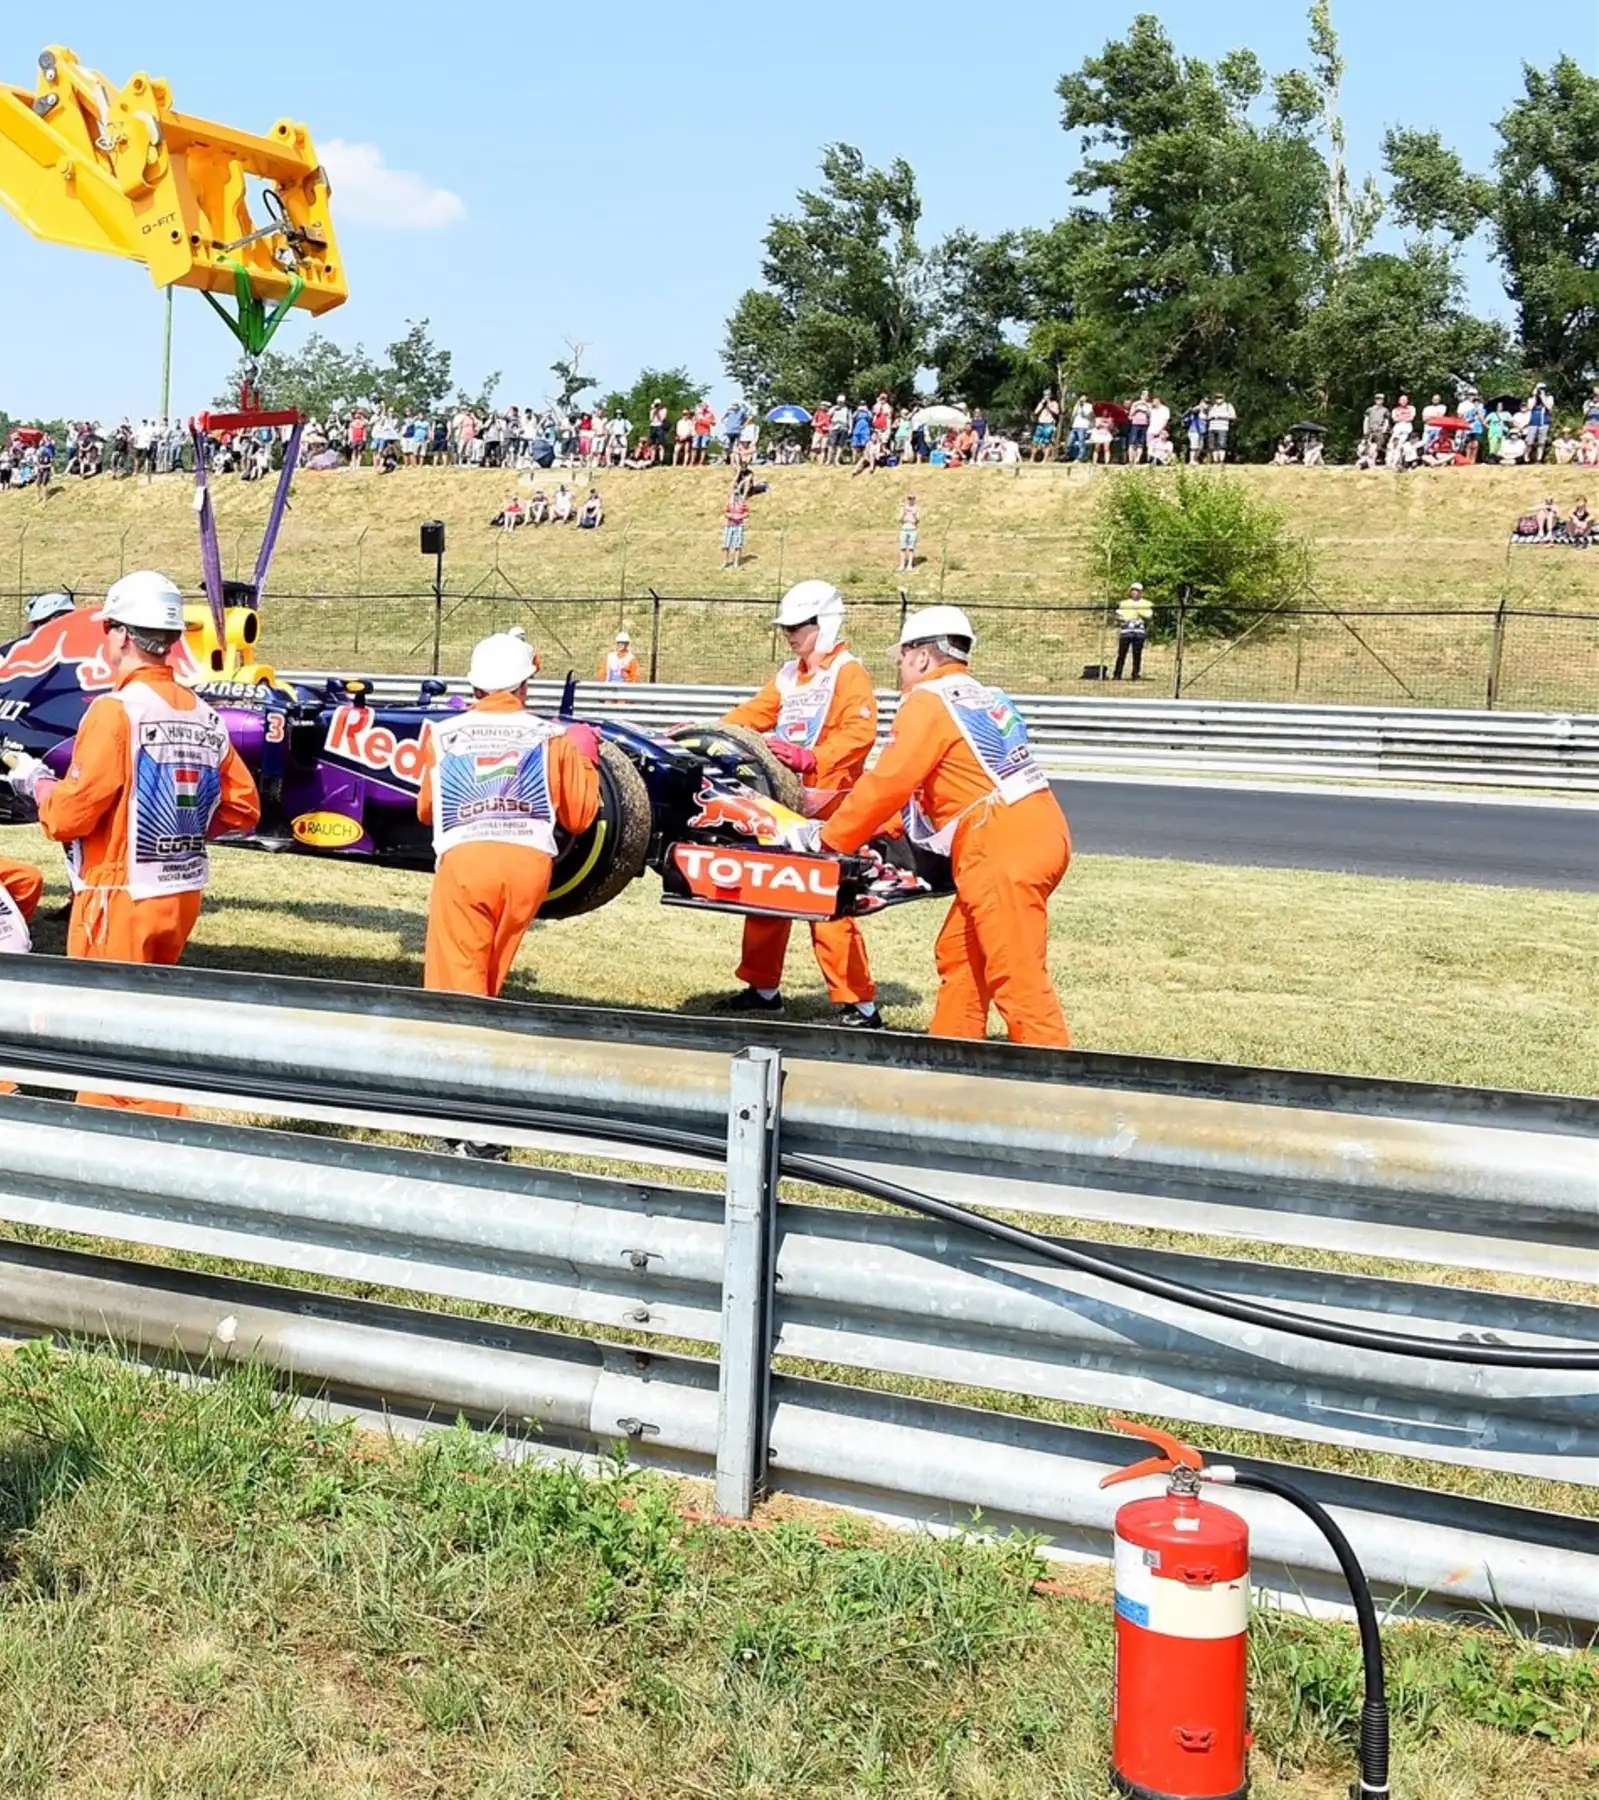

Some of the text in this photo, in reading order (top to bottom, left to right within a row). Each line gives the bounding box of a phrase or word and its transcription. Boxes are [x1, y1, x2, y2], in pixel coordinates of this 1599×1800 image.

[265, 711, 285, 743] 3
[325, 703, 432, 783] Red
[307, 822, 352, 837] RAUCH
[675, 849, 839, 896] TOTAL
